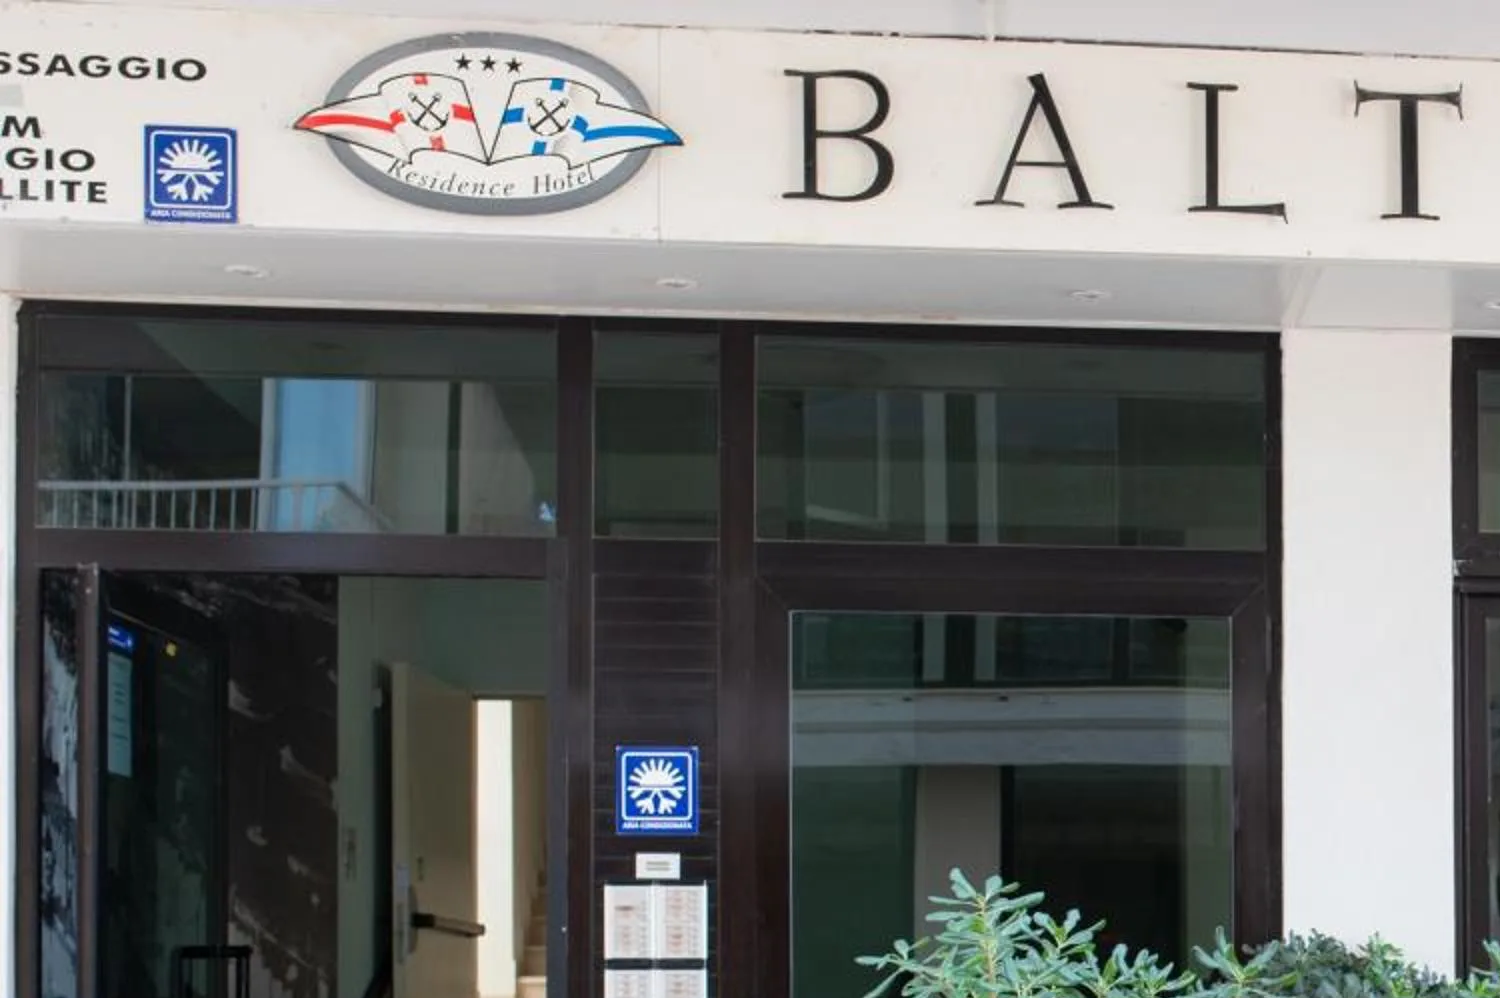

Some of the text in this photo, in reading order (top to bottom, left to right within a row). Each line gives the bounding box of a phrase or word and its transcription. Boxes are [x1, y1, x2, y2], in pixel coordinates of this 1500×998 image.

[0, 178, 108, 204] LLITE
[387, 158, 594, 195] Residence Hotel
